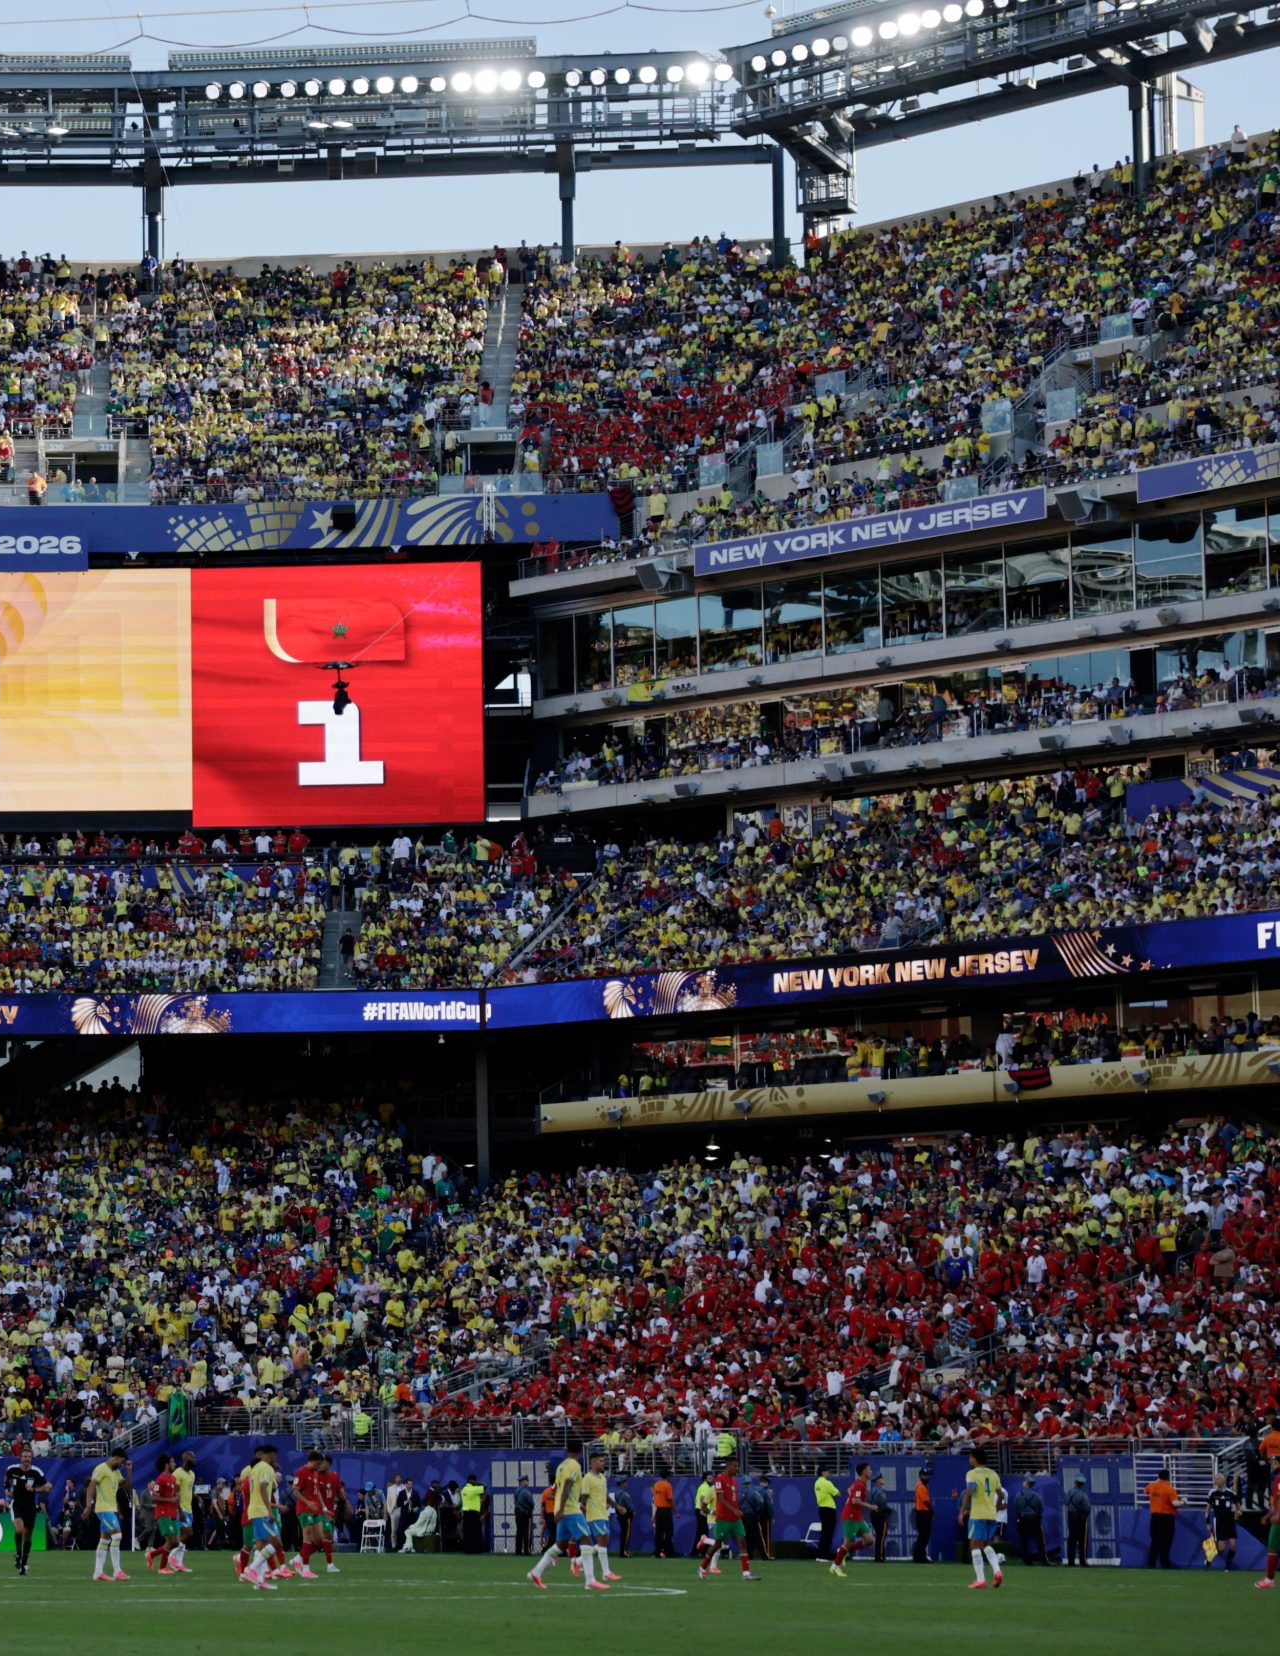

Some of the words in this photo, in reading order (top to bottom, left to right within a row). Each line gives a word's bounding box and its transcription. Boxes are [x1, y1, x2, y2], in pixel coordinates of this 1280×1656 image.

[100, 443, 114, 451] 331
[497, 433, 512, 441] 332
[708, 540, 767, 567] NEW
[772, 527, 846, 556] YORK
[851, 516, 914, 545] NEW
[919, 496, 1029, 532] JERSEY
[297, 700, 384, 786] 1
[773, 968, 824, 994] NEW
[828, 964, 891, 991] YORK
[894, 958, 946, 983] NEW
[950, 949, 1039, 979] JERSEY
[362, 1001, 493, 1023] #FIFAWorldCup
